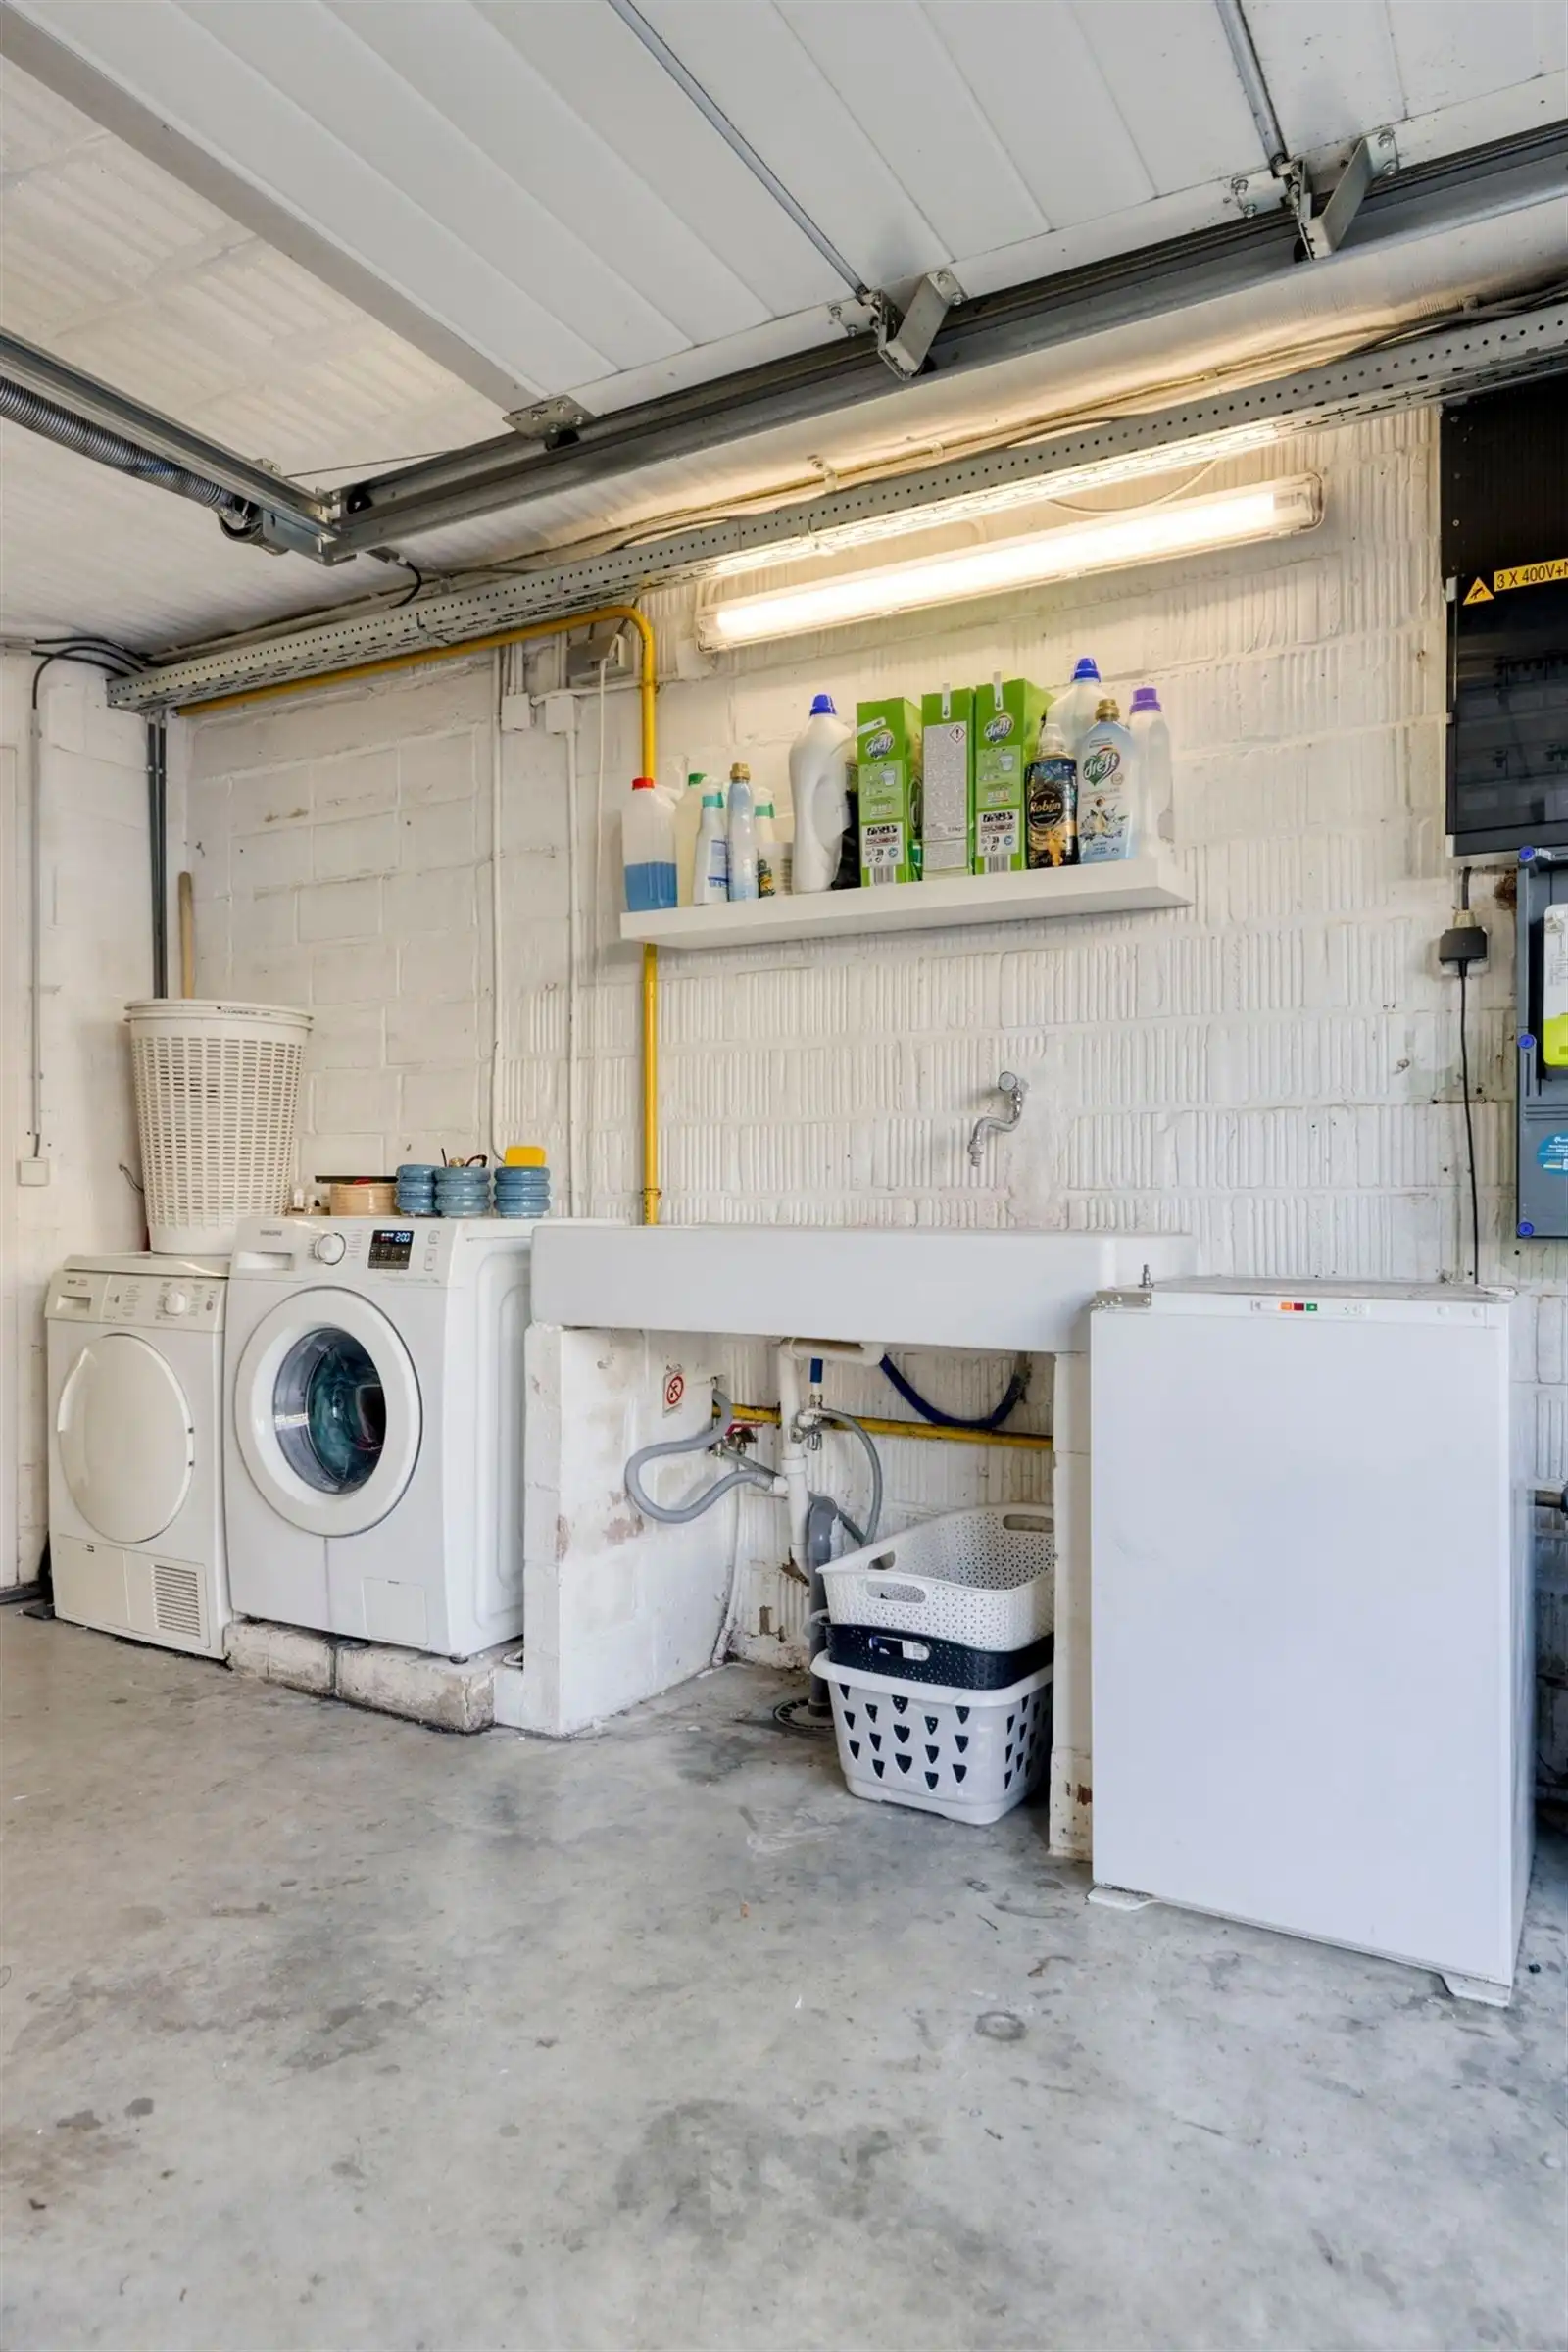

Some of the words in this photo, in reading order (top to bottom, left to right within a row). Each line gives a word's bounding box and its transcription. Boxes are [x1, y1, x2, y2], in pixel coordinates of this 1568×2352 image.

[1496, 573, 1505, 589] 3
[1509, 570, 1518, 586] X
[1030, 799, 1062, 814] Robijn
